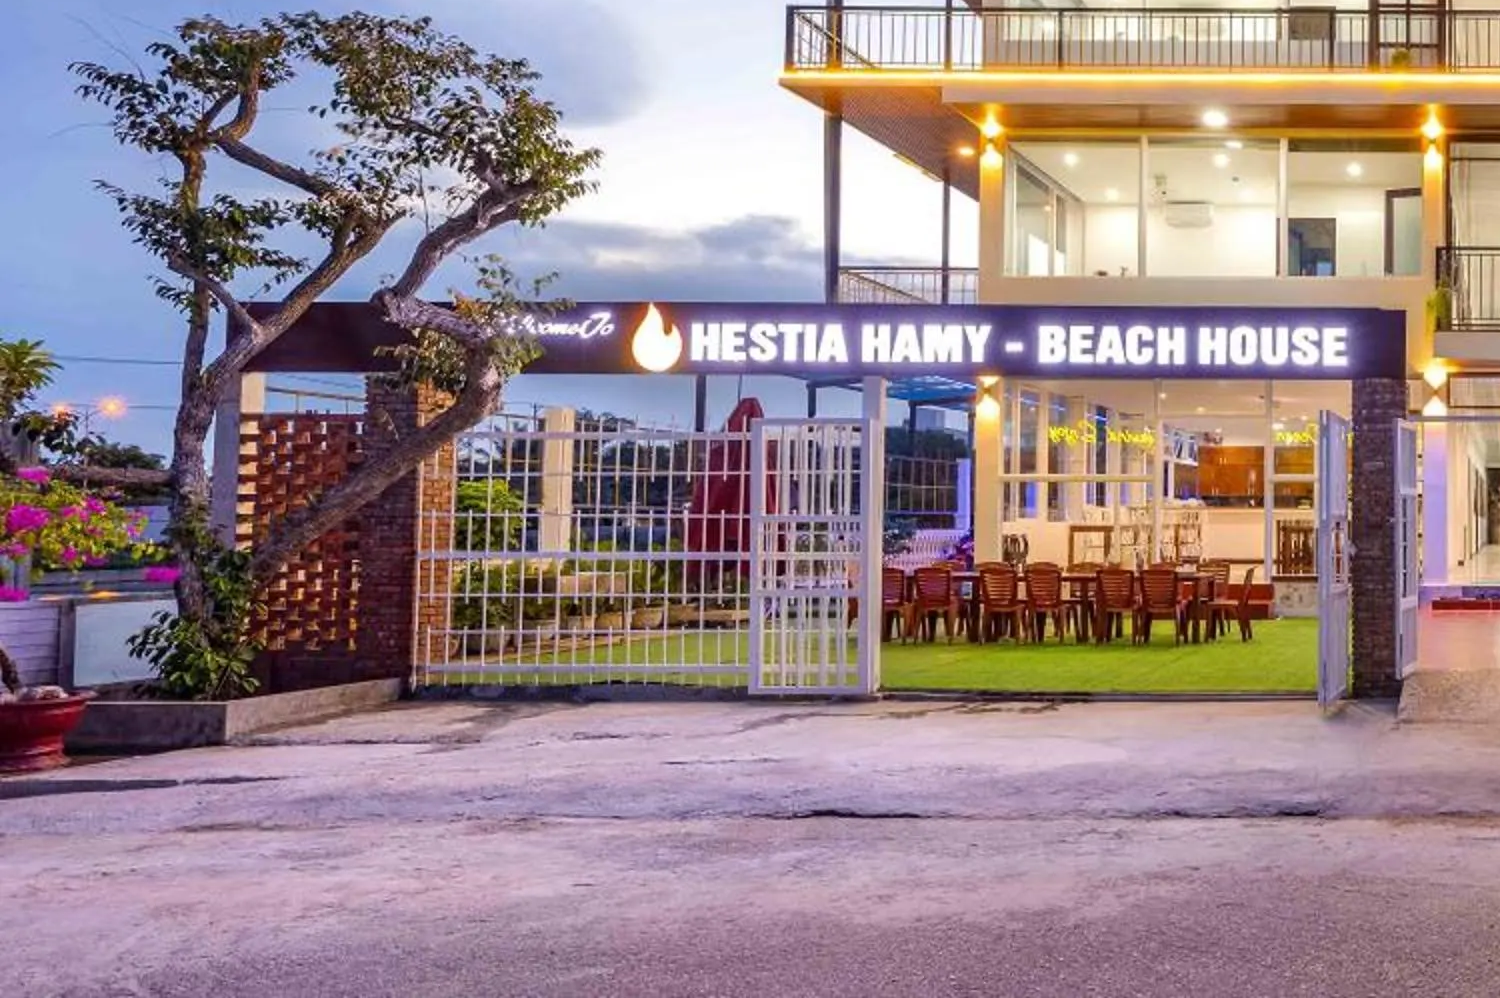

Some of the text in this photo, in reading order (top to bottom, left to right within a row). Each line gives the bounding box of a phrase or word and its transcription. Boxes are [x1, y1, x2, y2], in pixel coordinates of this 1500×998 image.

[690, 322, 849, 363] HESTIA
[861, 323, 992, 363] HAMY
[1037, 325, 1187, 365] BEACH
[1198, 326, 1348, 366] HOUSE
